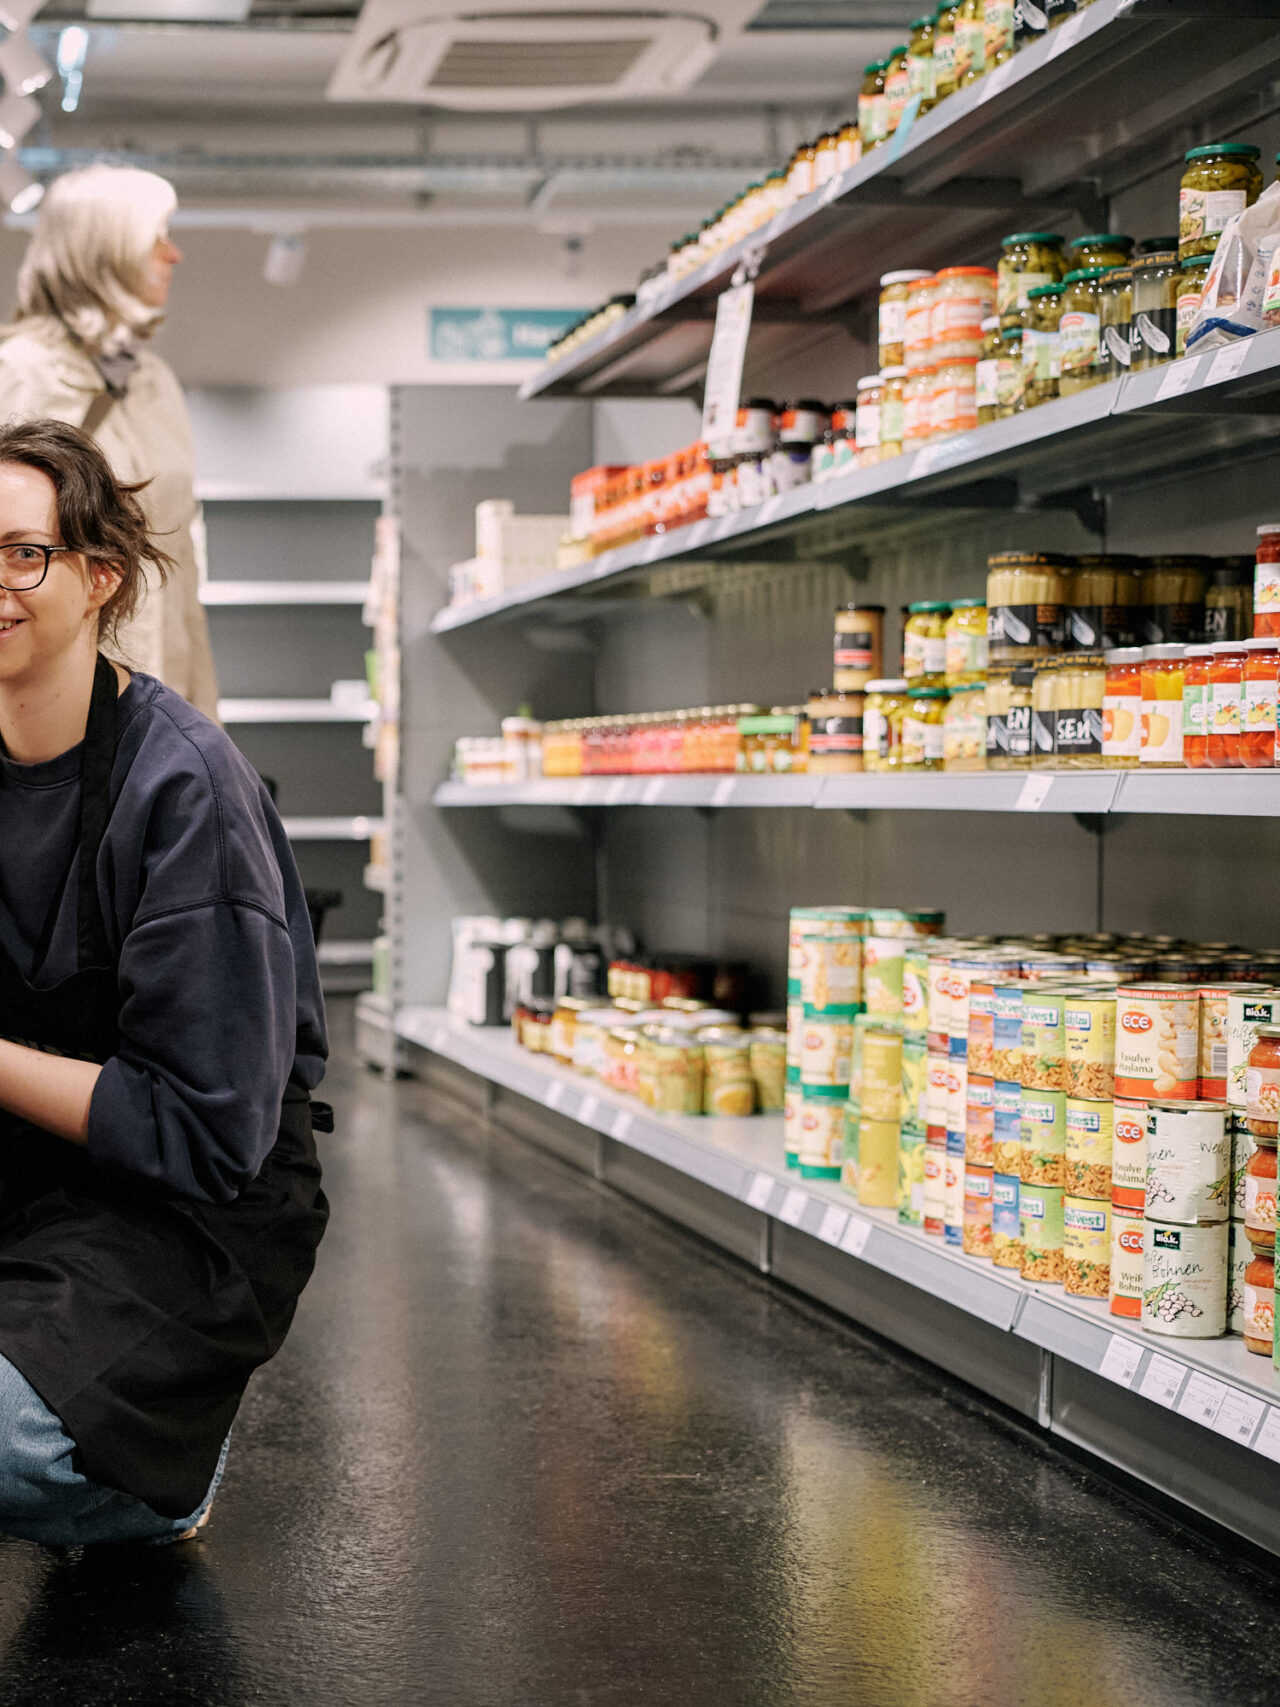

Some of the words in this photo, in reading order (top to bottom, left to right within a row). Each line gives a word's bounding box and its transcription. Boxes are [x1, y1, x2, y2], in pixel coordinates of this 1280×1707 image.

[1122, 1015, 1150, 1030] ECE
[1116, 1124, 1141, 1139] ECE
[1152, 1257, 1204, 1279] Bohnen
